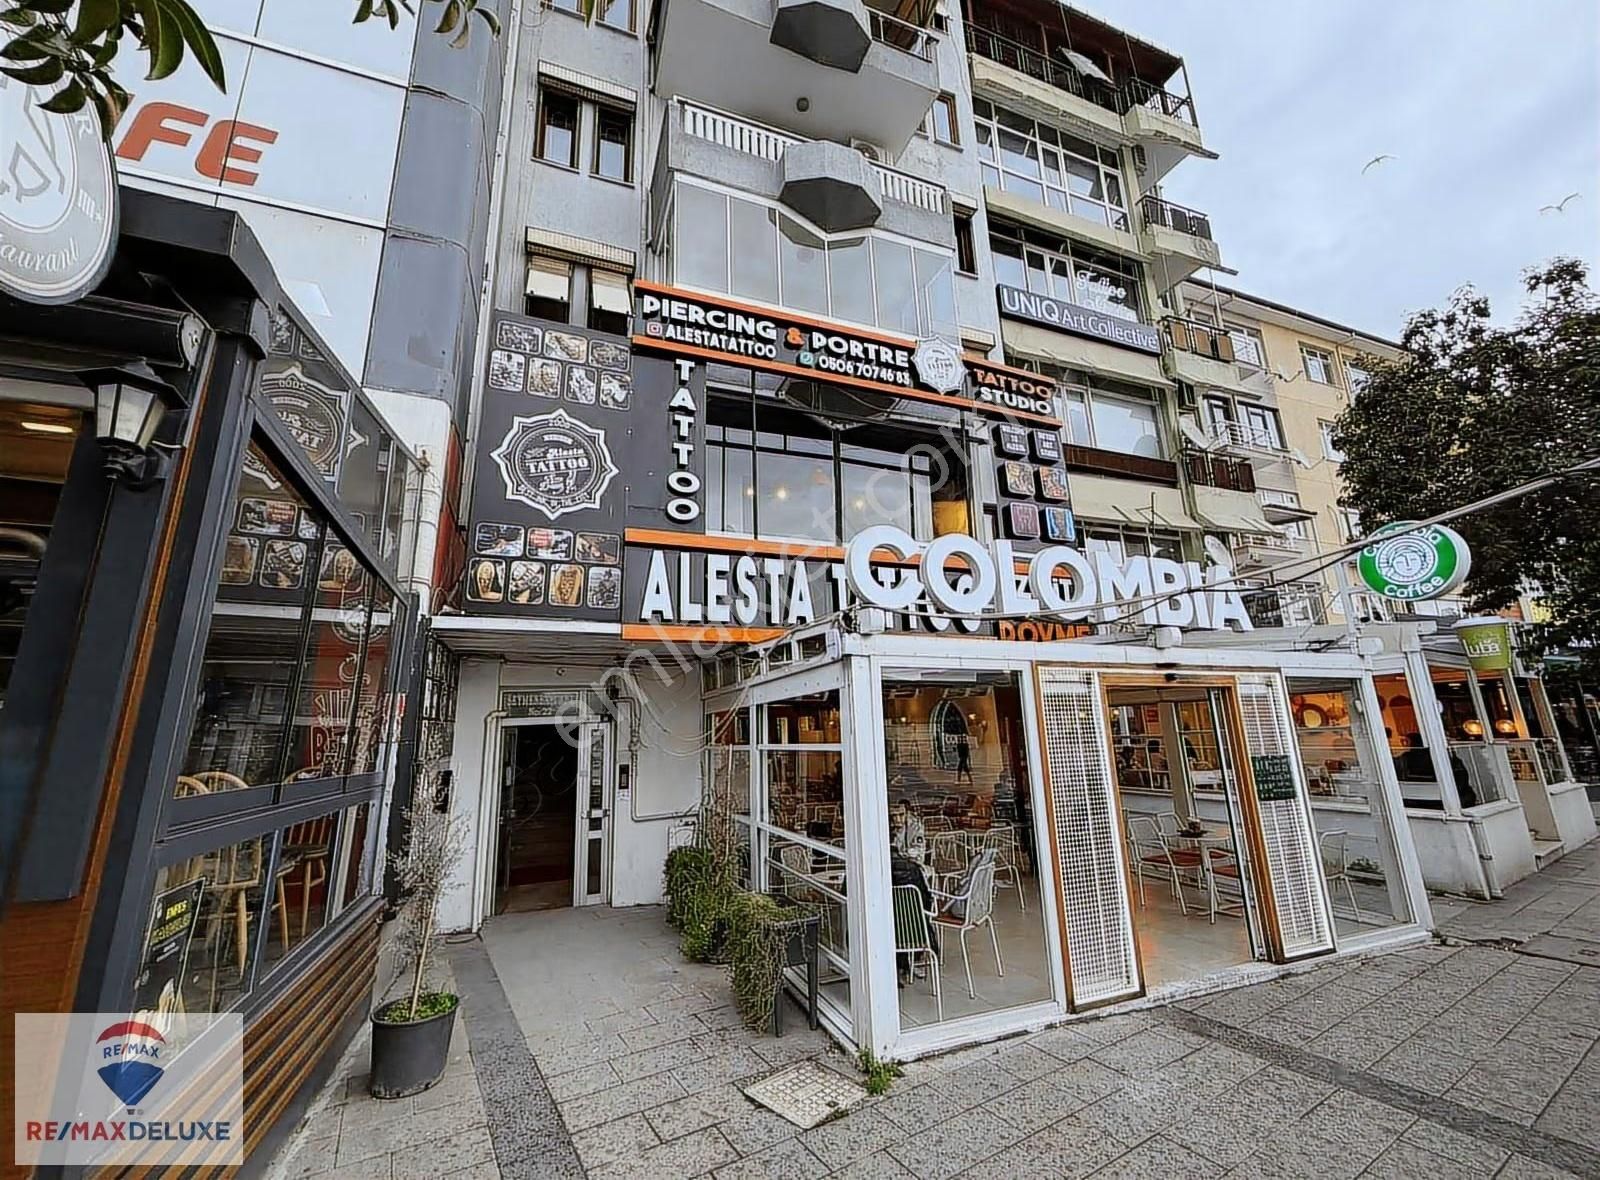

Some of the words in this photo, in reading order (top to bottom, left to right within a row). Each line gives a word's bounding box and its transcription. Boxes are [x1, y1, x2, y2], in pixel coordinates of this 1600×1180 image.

[643, 294, 777, 340] PIERCING
[812, 332, 909, 367] PORTRE
[665, 324, 777, 358] ALESTATATTOO
[1002, 287, 1060, 323] UNIQ
[1062, 309, 1087, 331] Art
[1088, 316, 1158, 349] Collective
[973, 368, 1053, 400] TATTOO
[980, 386, 1053, 415] STUDIO
[665, 358, 701, 521] TATTOO
[525, 457, 590, 474] TATTOO
[640, 549, 814, 625] ALESTA
[846, 525, 1253, 630] COLOMBIA
[1383, 576, 1444, 597] Coffee
